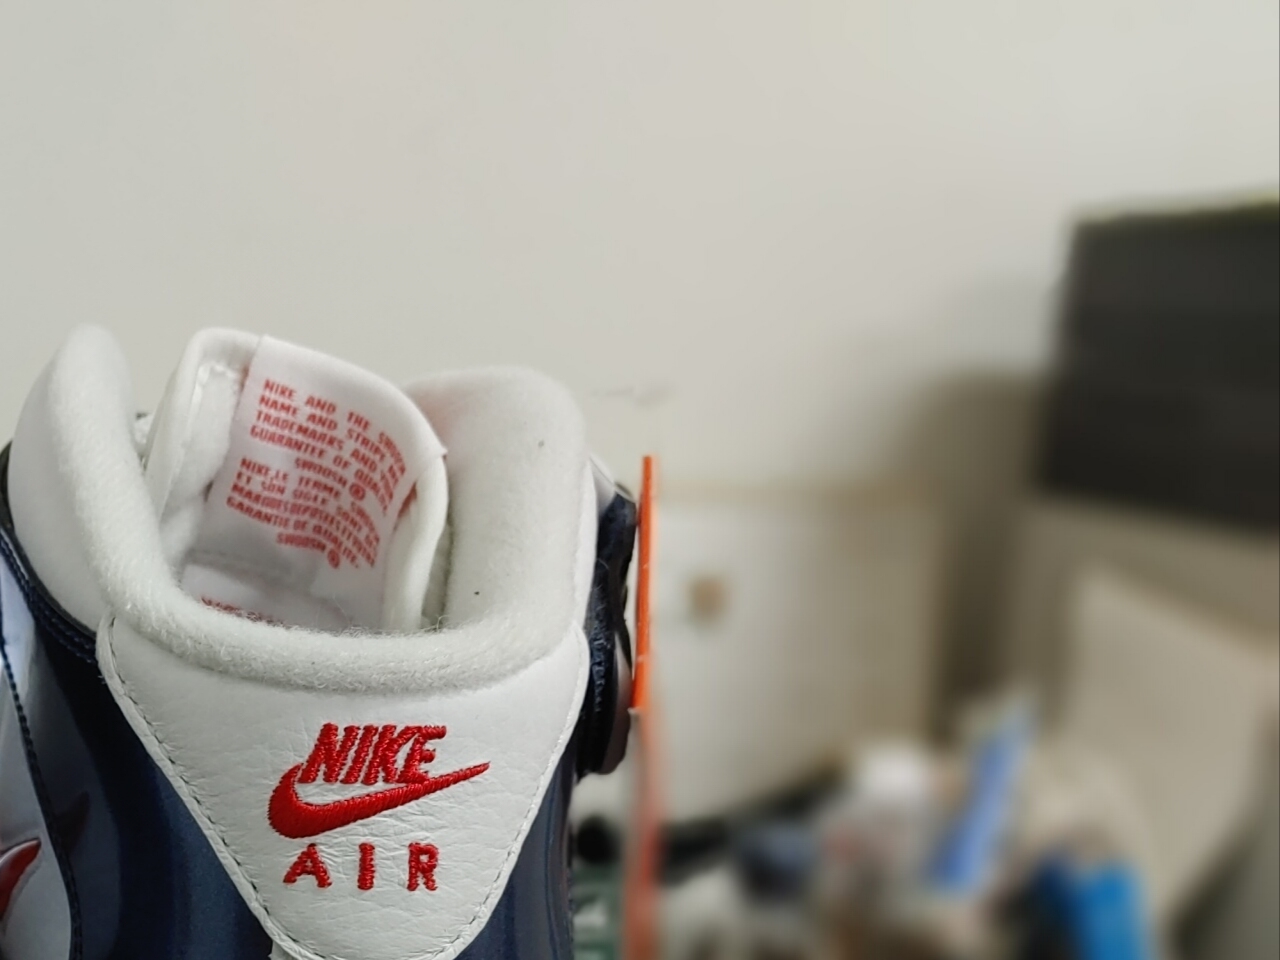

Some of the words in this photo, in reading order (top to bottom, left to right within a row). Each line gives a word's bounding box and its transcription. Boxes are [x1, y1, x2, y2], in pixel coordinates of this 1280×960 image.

[259, 394, 299, 417] NAME
[307, 412, 338, 431] AND
[263, 379, 297, 400] NIKE
[305, 395, 336, 414] AND
[346, 411, 370, 432] THE
[250, 425, 327, 459] GUARANTEE
[332, 455, 351, 470] OF
[255, 409, 345, 451] TRADEMARKS
[350, 448, 378, 473] AND
[295, 457, 348, 489] SWOOSH
[297, 723, 447, 785] NIKE
[283, 842, 439, 892] AIR
